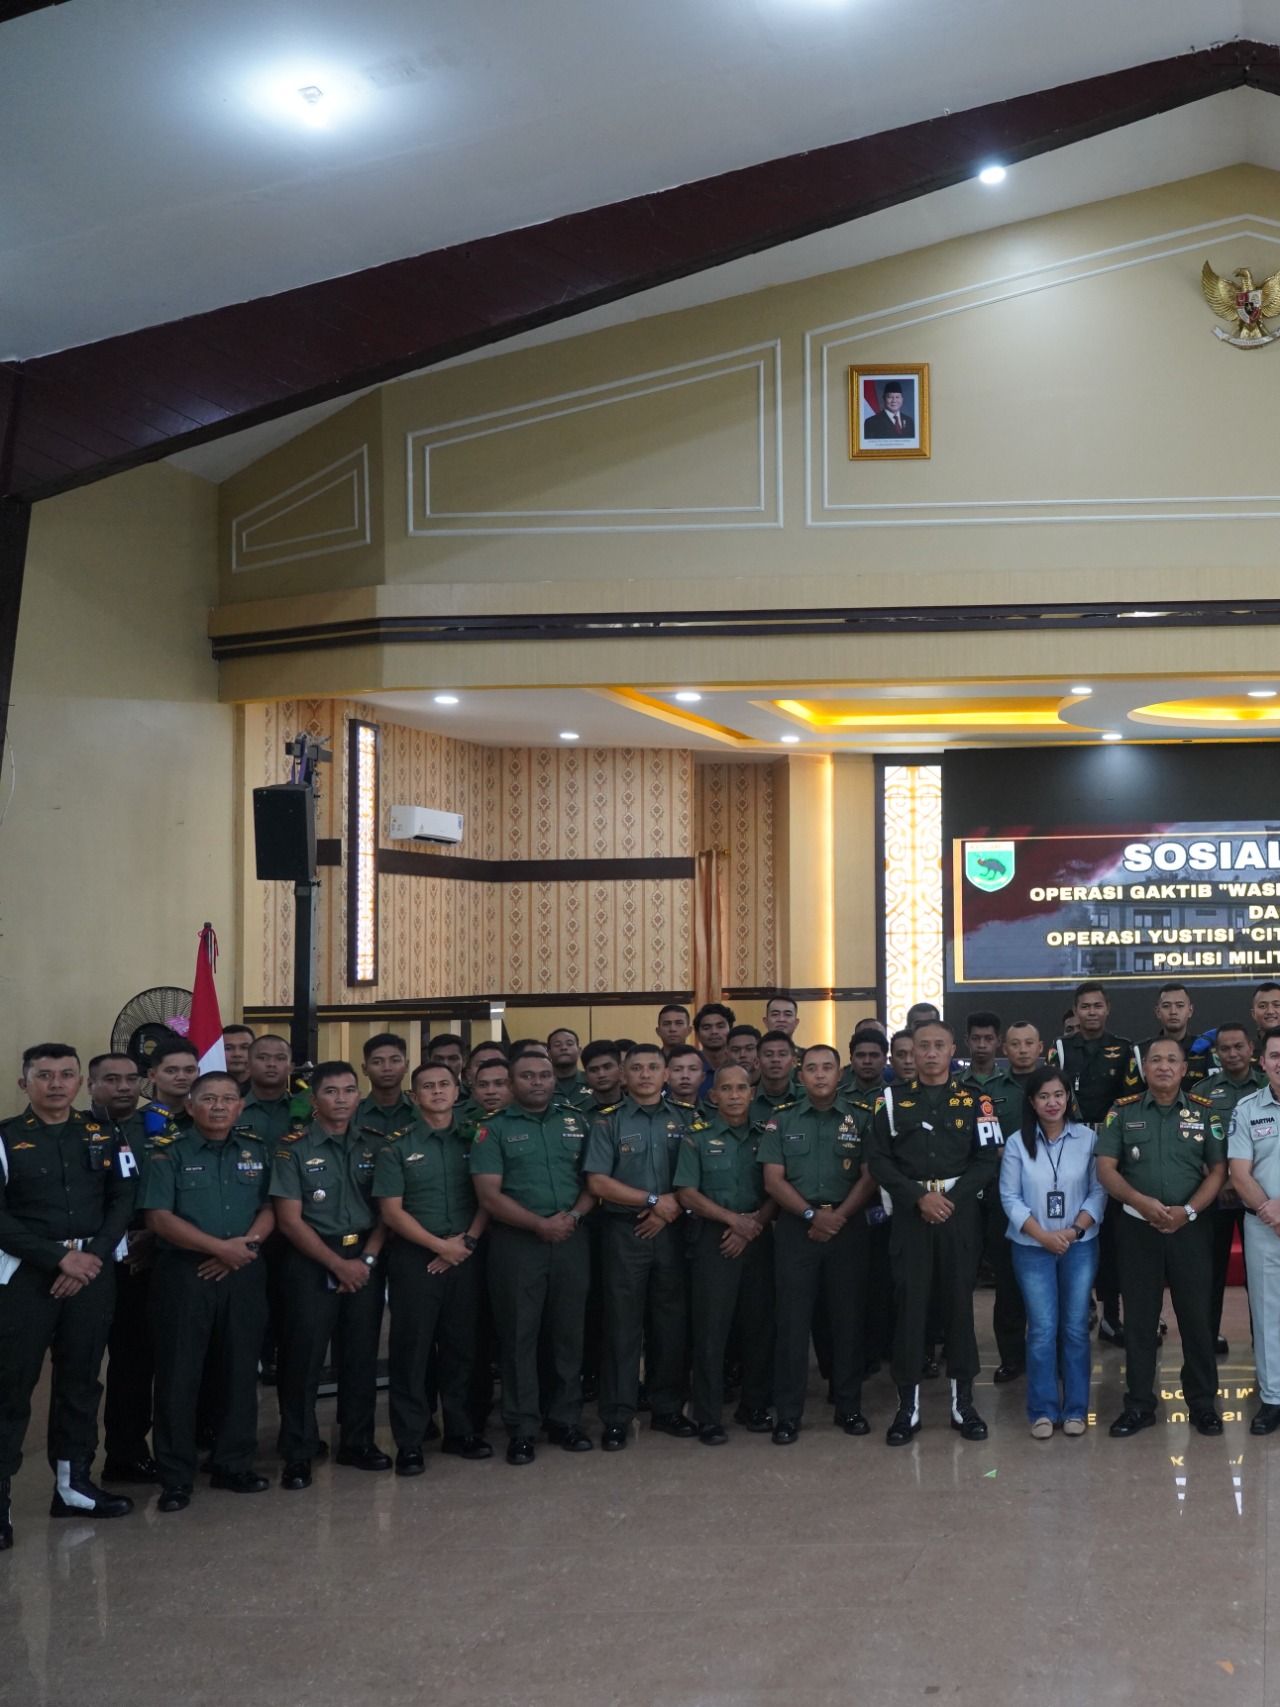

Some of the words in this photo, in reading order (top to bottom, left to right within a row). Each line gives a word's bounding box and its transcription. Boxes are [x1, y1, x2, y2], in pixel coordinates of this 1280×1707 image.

[1030, 886, 1123, 901] OPERASI
[1130, 884, 1212, 899] GAKTIB
[1047, 930, 1140, 946] OPERASI
[1148, 928, 1234, 943] YUSTISI
[1154, 951, 1221, 966] POLISI
